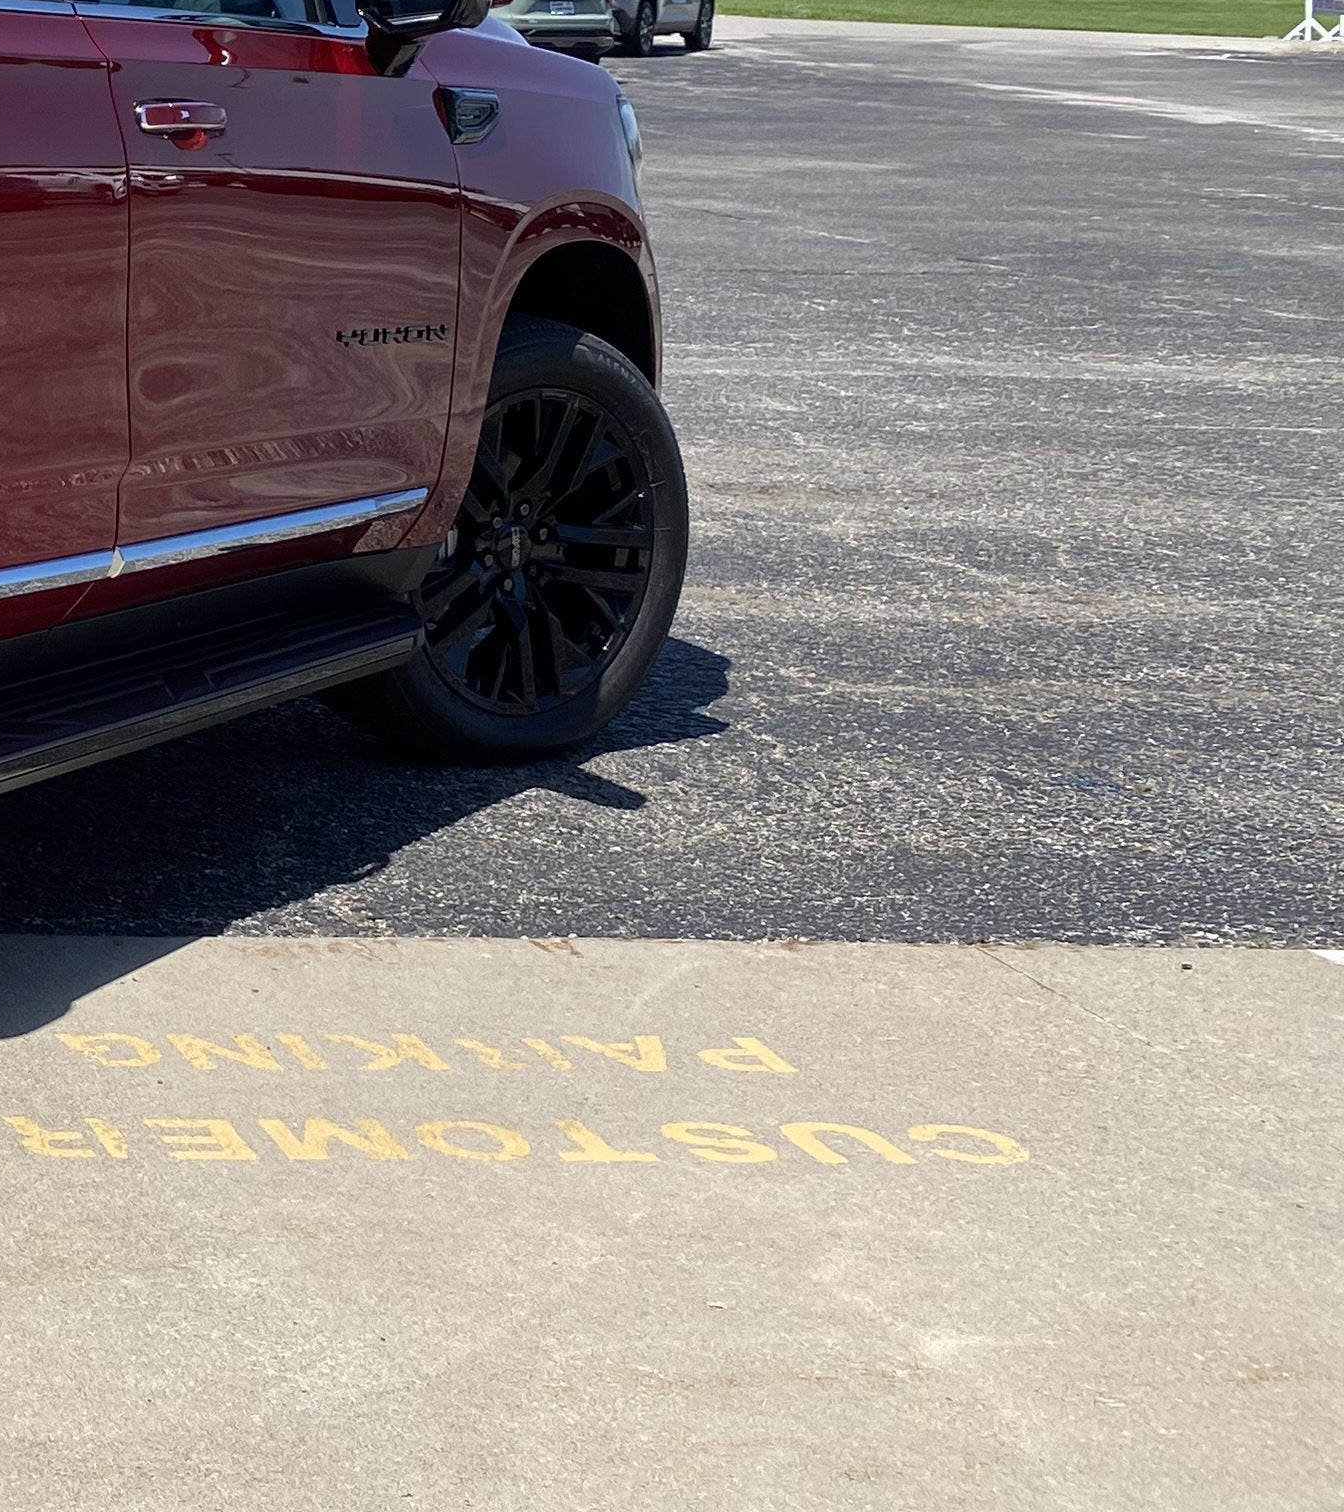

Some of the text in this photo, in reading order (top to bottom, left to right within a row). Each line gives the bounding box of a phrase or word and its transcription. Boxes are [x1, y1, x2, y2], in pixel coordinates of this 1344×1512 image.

[336, 324, 449, 348] YUKON
[56, 1032, 799, 1074] PARKING
[2, 1115, 1030, 1166] CUSTOMER
